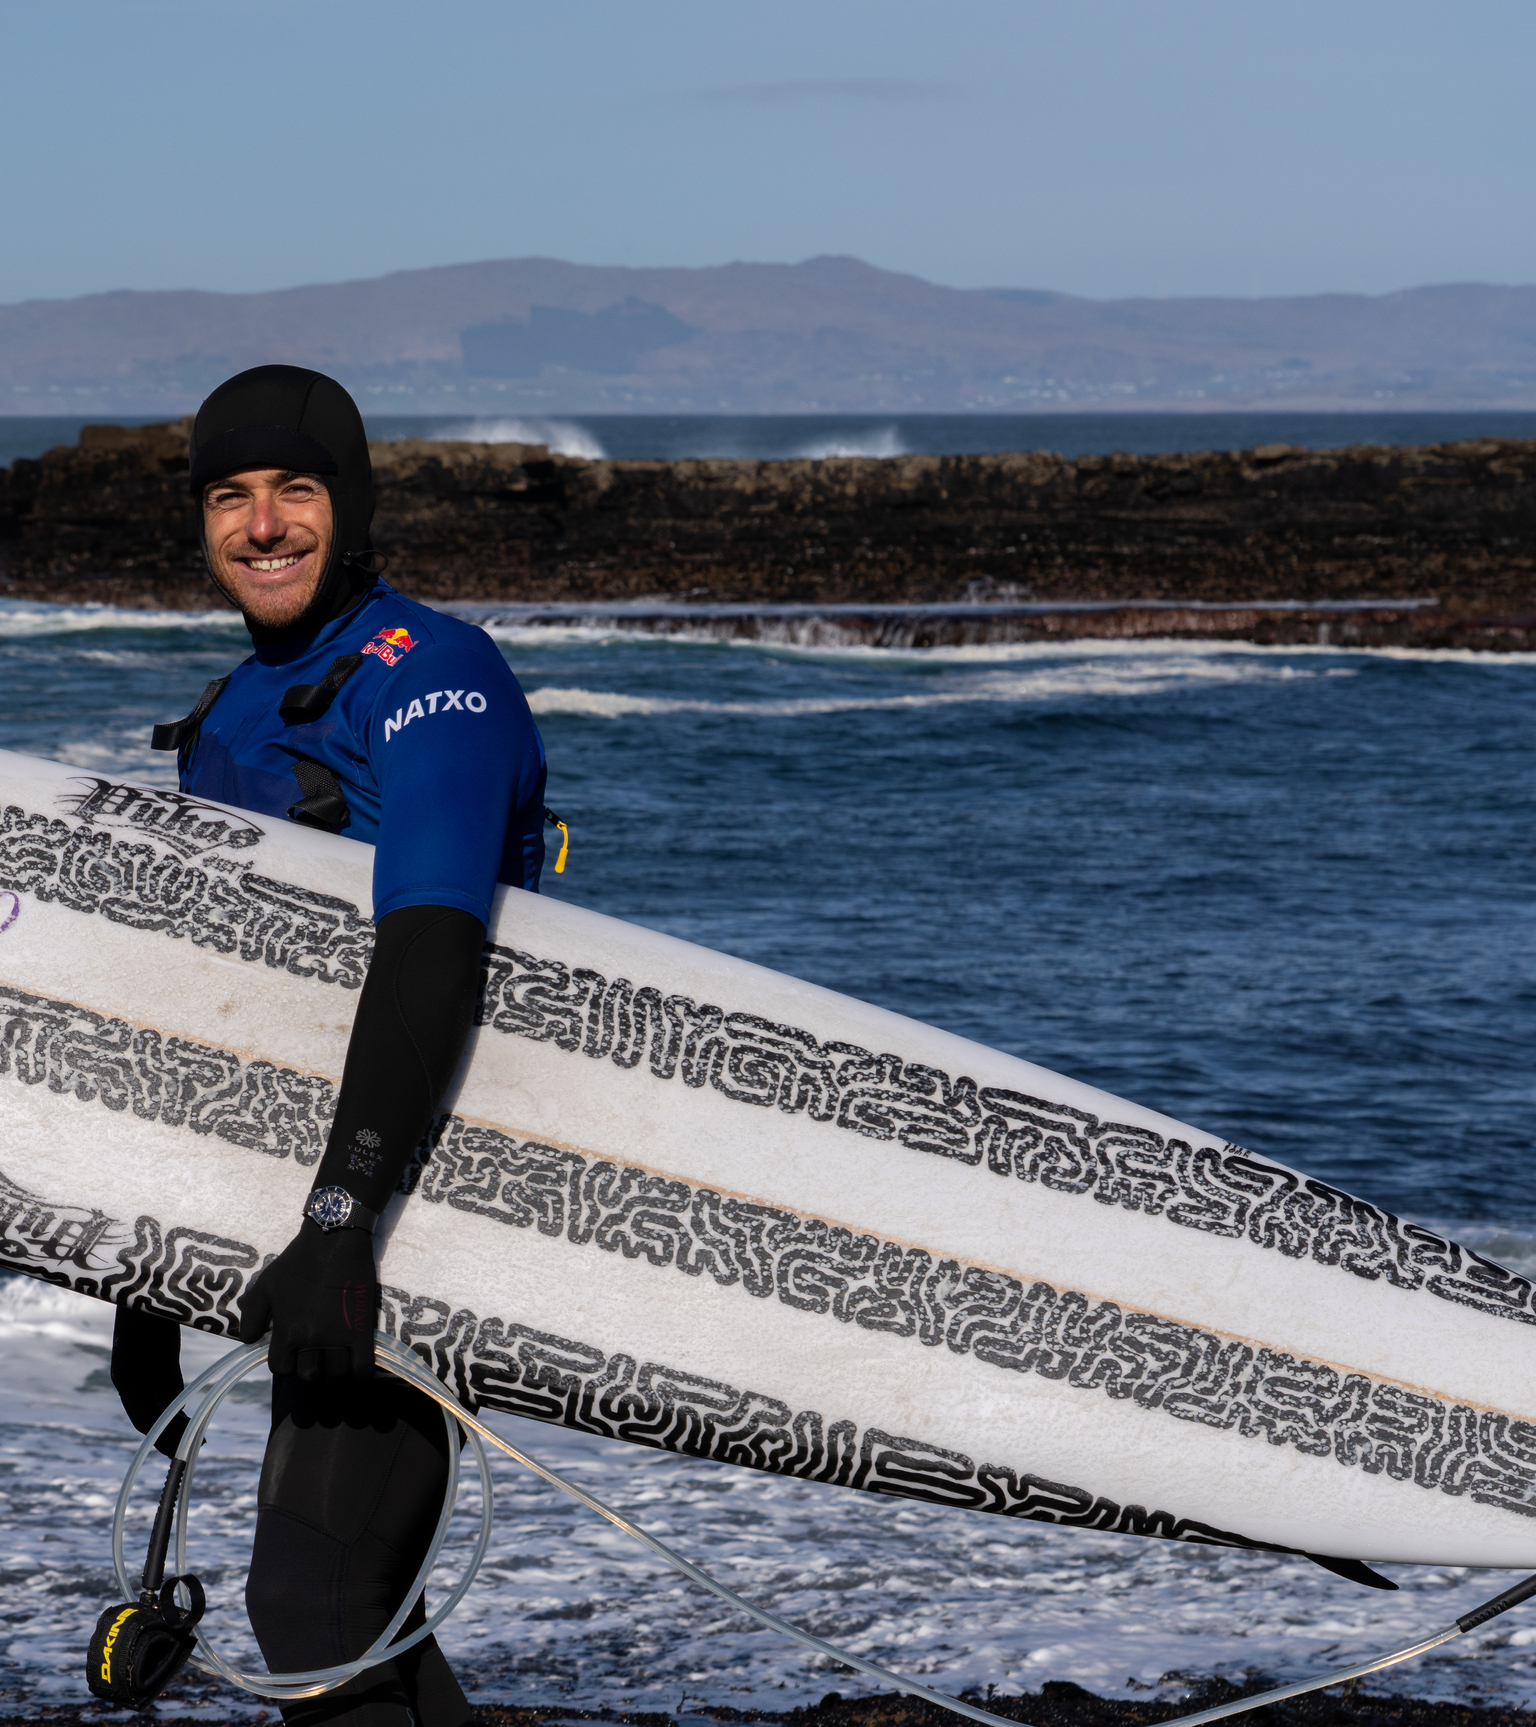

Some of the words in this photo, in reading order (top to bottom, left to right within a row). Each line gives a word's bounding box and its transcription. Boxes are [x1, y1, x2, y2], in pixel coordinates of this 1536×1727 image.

[377, 645, 404, 667] Bul
[384, 690, 487, 743] NATXO
[54, 776, 266, 849] Pukas
[347, 1144, 383, 1161] YULEX
[354, 1280, 368, 1331] OXBOW
[101, 1608, 139, 1684] DAKINE
